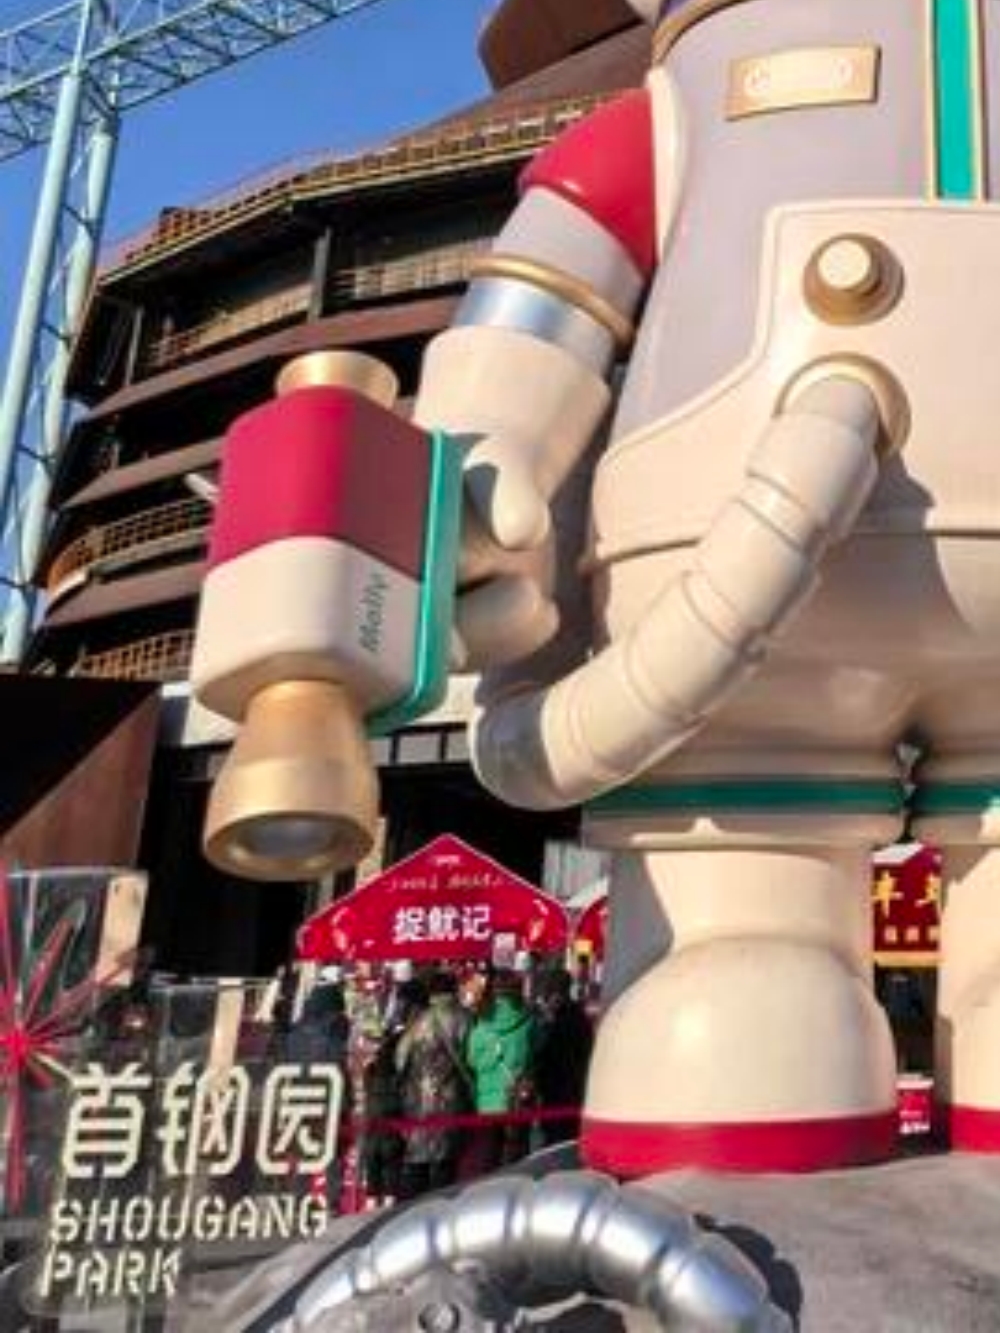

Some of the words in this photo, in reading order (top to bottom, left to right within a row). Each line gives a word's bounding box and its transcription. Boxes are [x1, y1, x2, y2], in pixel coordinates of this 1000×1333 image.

[61, 1063, 344, 1178] 首钢园
[49, 1194, 328, 1243] SHOUGANG
[39, 1246, 183, 1299] PARK
